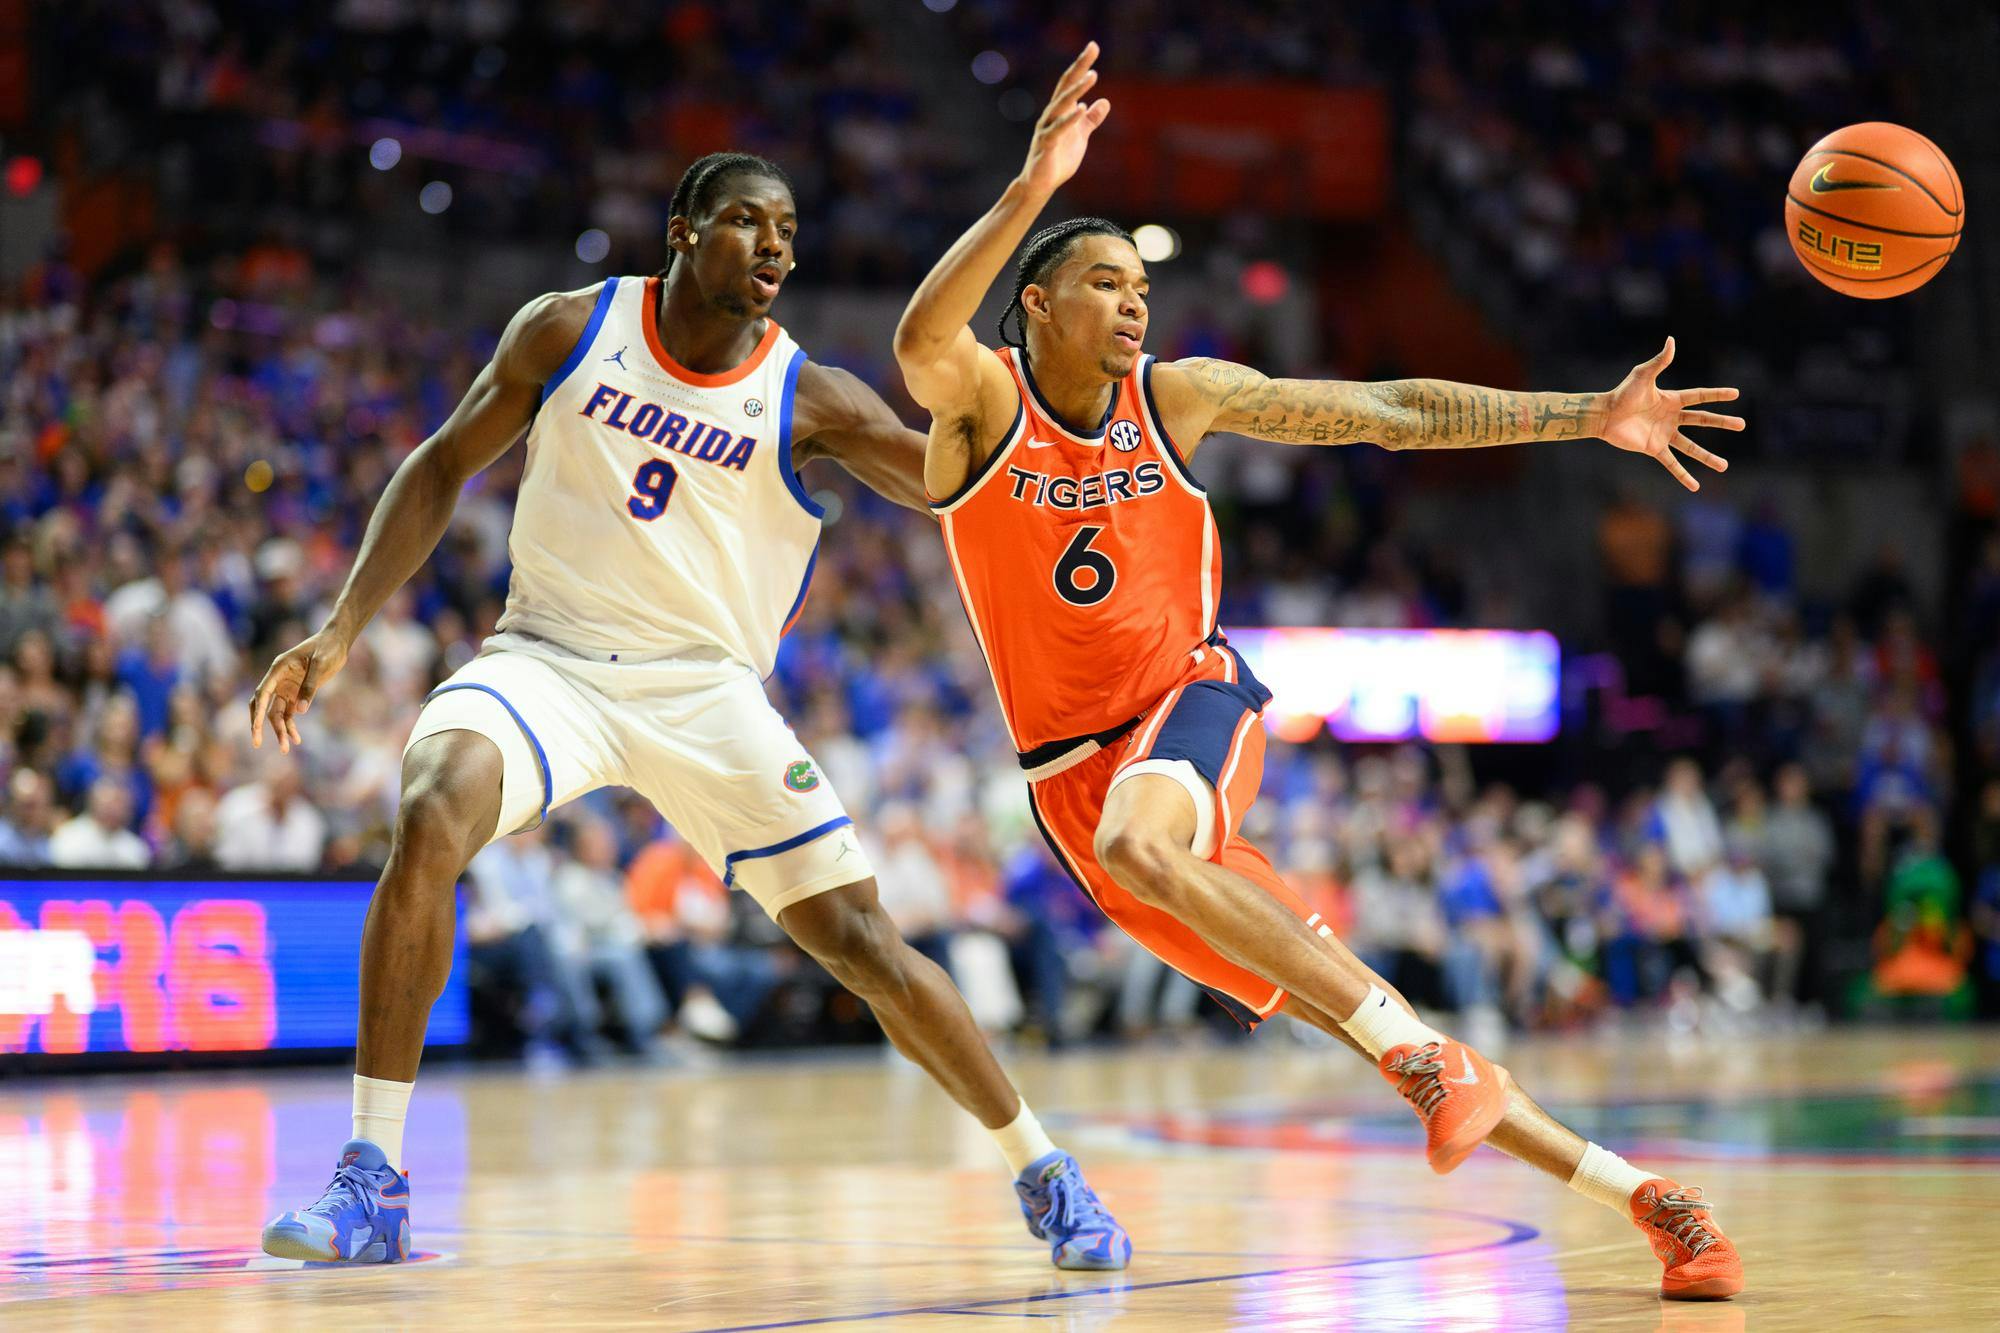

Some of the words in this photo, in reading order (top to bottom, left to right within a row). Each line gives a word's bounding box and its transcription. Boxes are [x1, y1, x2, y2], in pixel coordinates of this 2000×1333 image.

[1798, 220, 1884, 265] ELITE
[578, 382, 758, 472] FLORIDA
[1110, 420, 1141, 451] SEC
[626, 457, 679, 522] 9
[1006, 460, 1167, 512] TIGERS
[1052, 525, 1118, 607] 6
